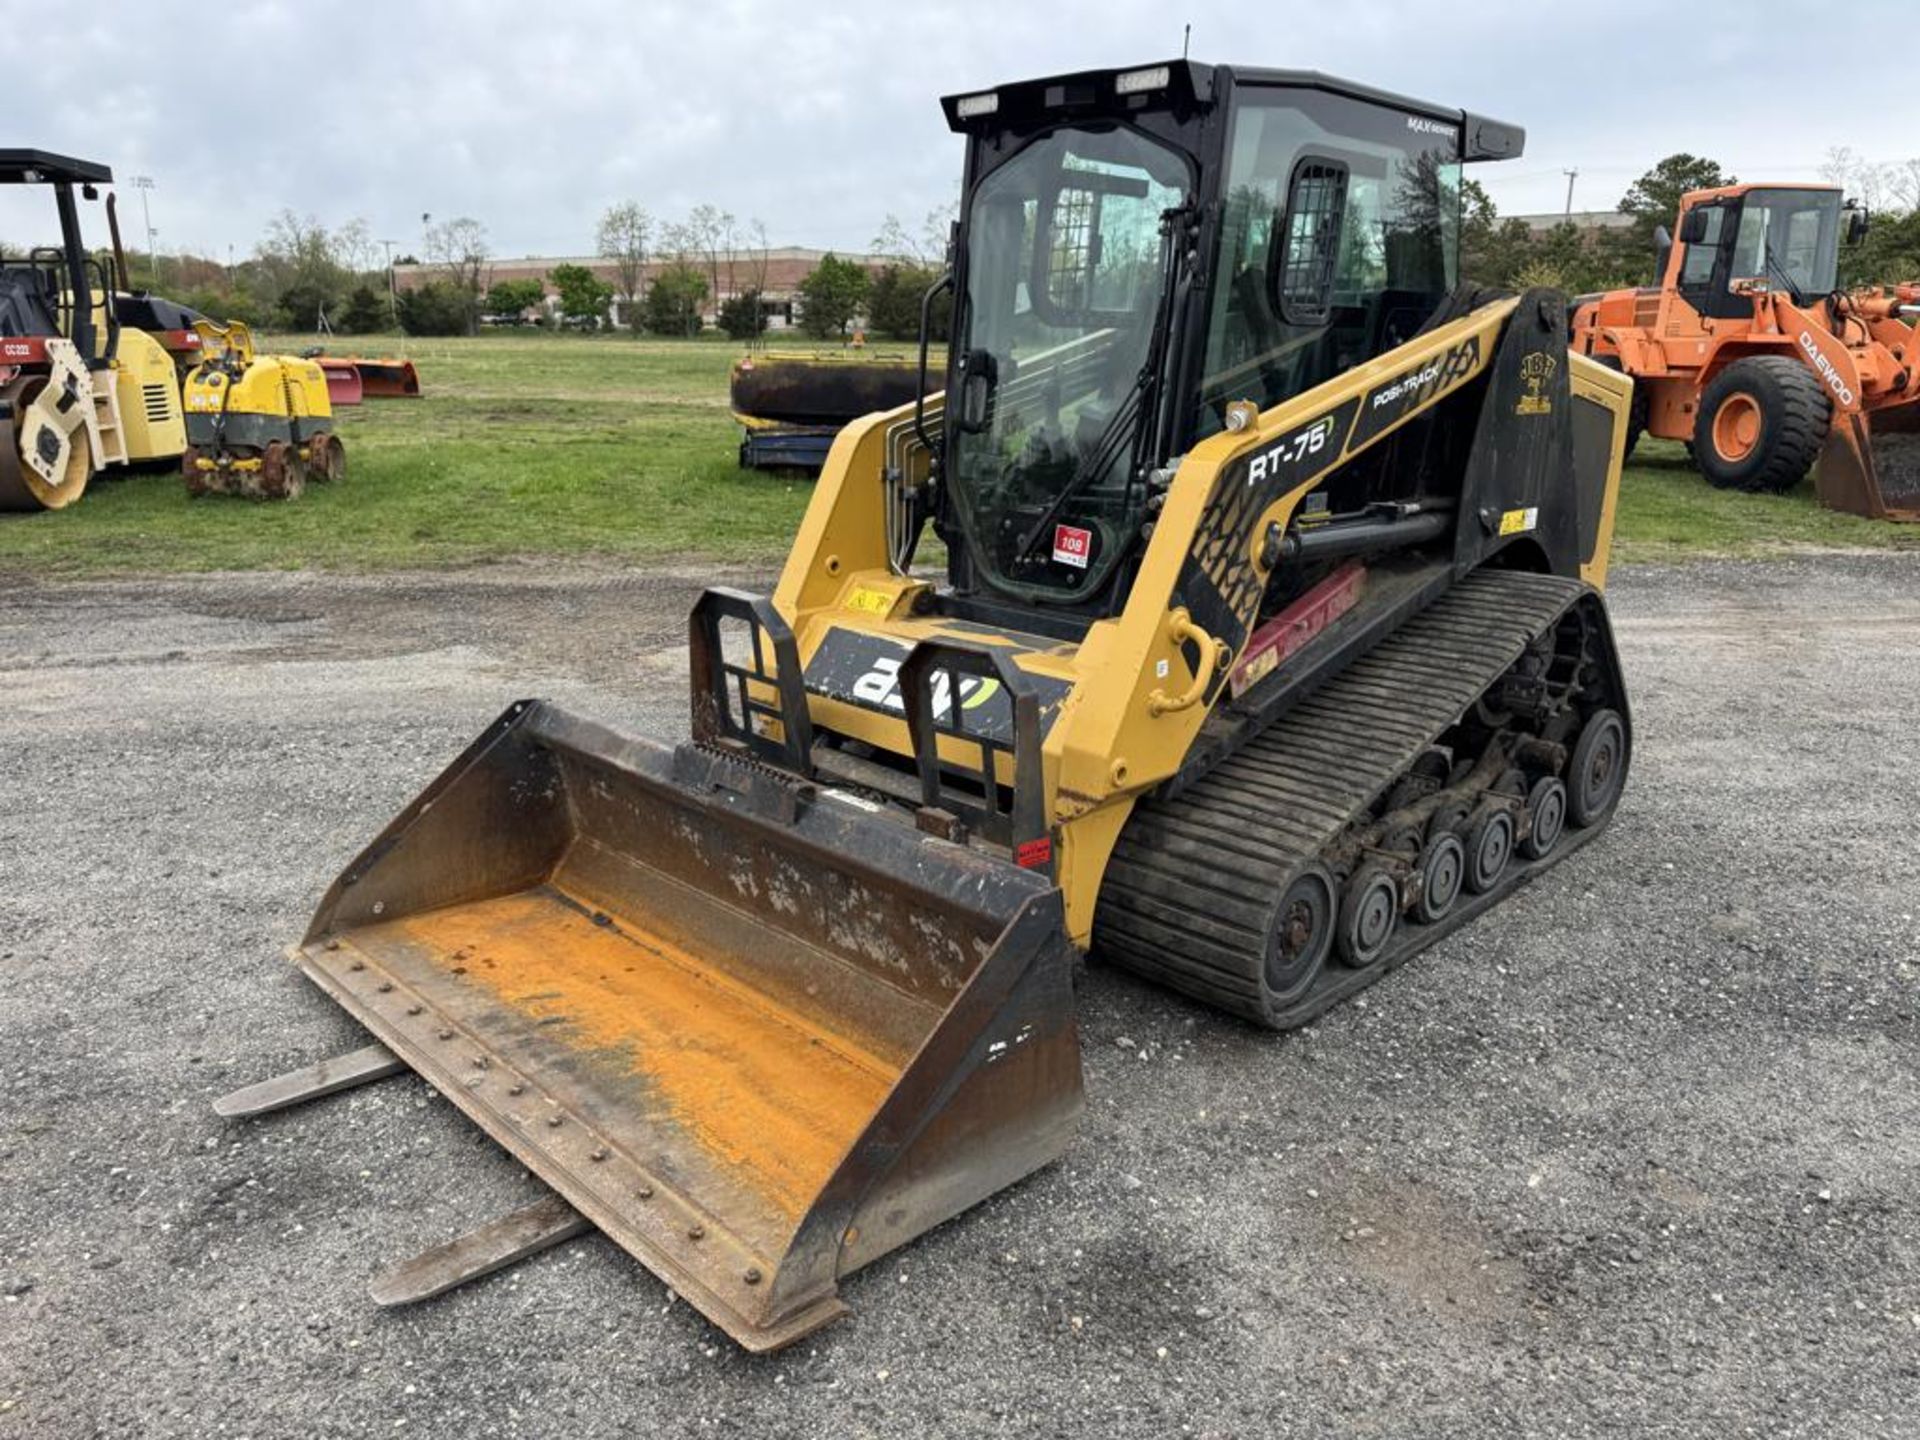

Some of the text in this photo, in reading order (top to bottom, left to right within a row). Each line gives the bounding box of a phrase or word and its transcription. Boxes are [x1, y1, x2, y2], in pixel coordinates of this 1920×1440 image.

[1373, 363, 1440, 409] POSI-TRACK
[1799, 330, 1853, 406] DAEWOO
[1248, 424, 1326, 487] RT-75
